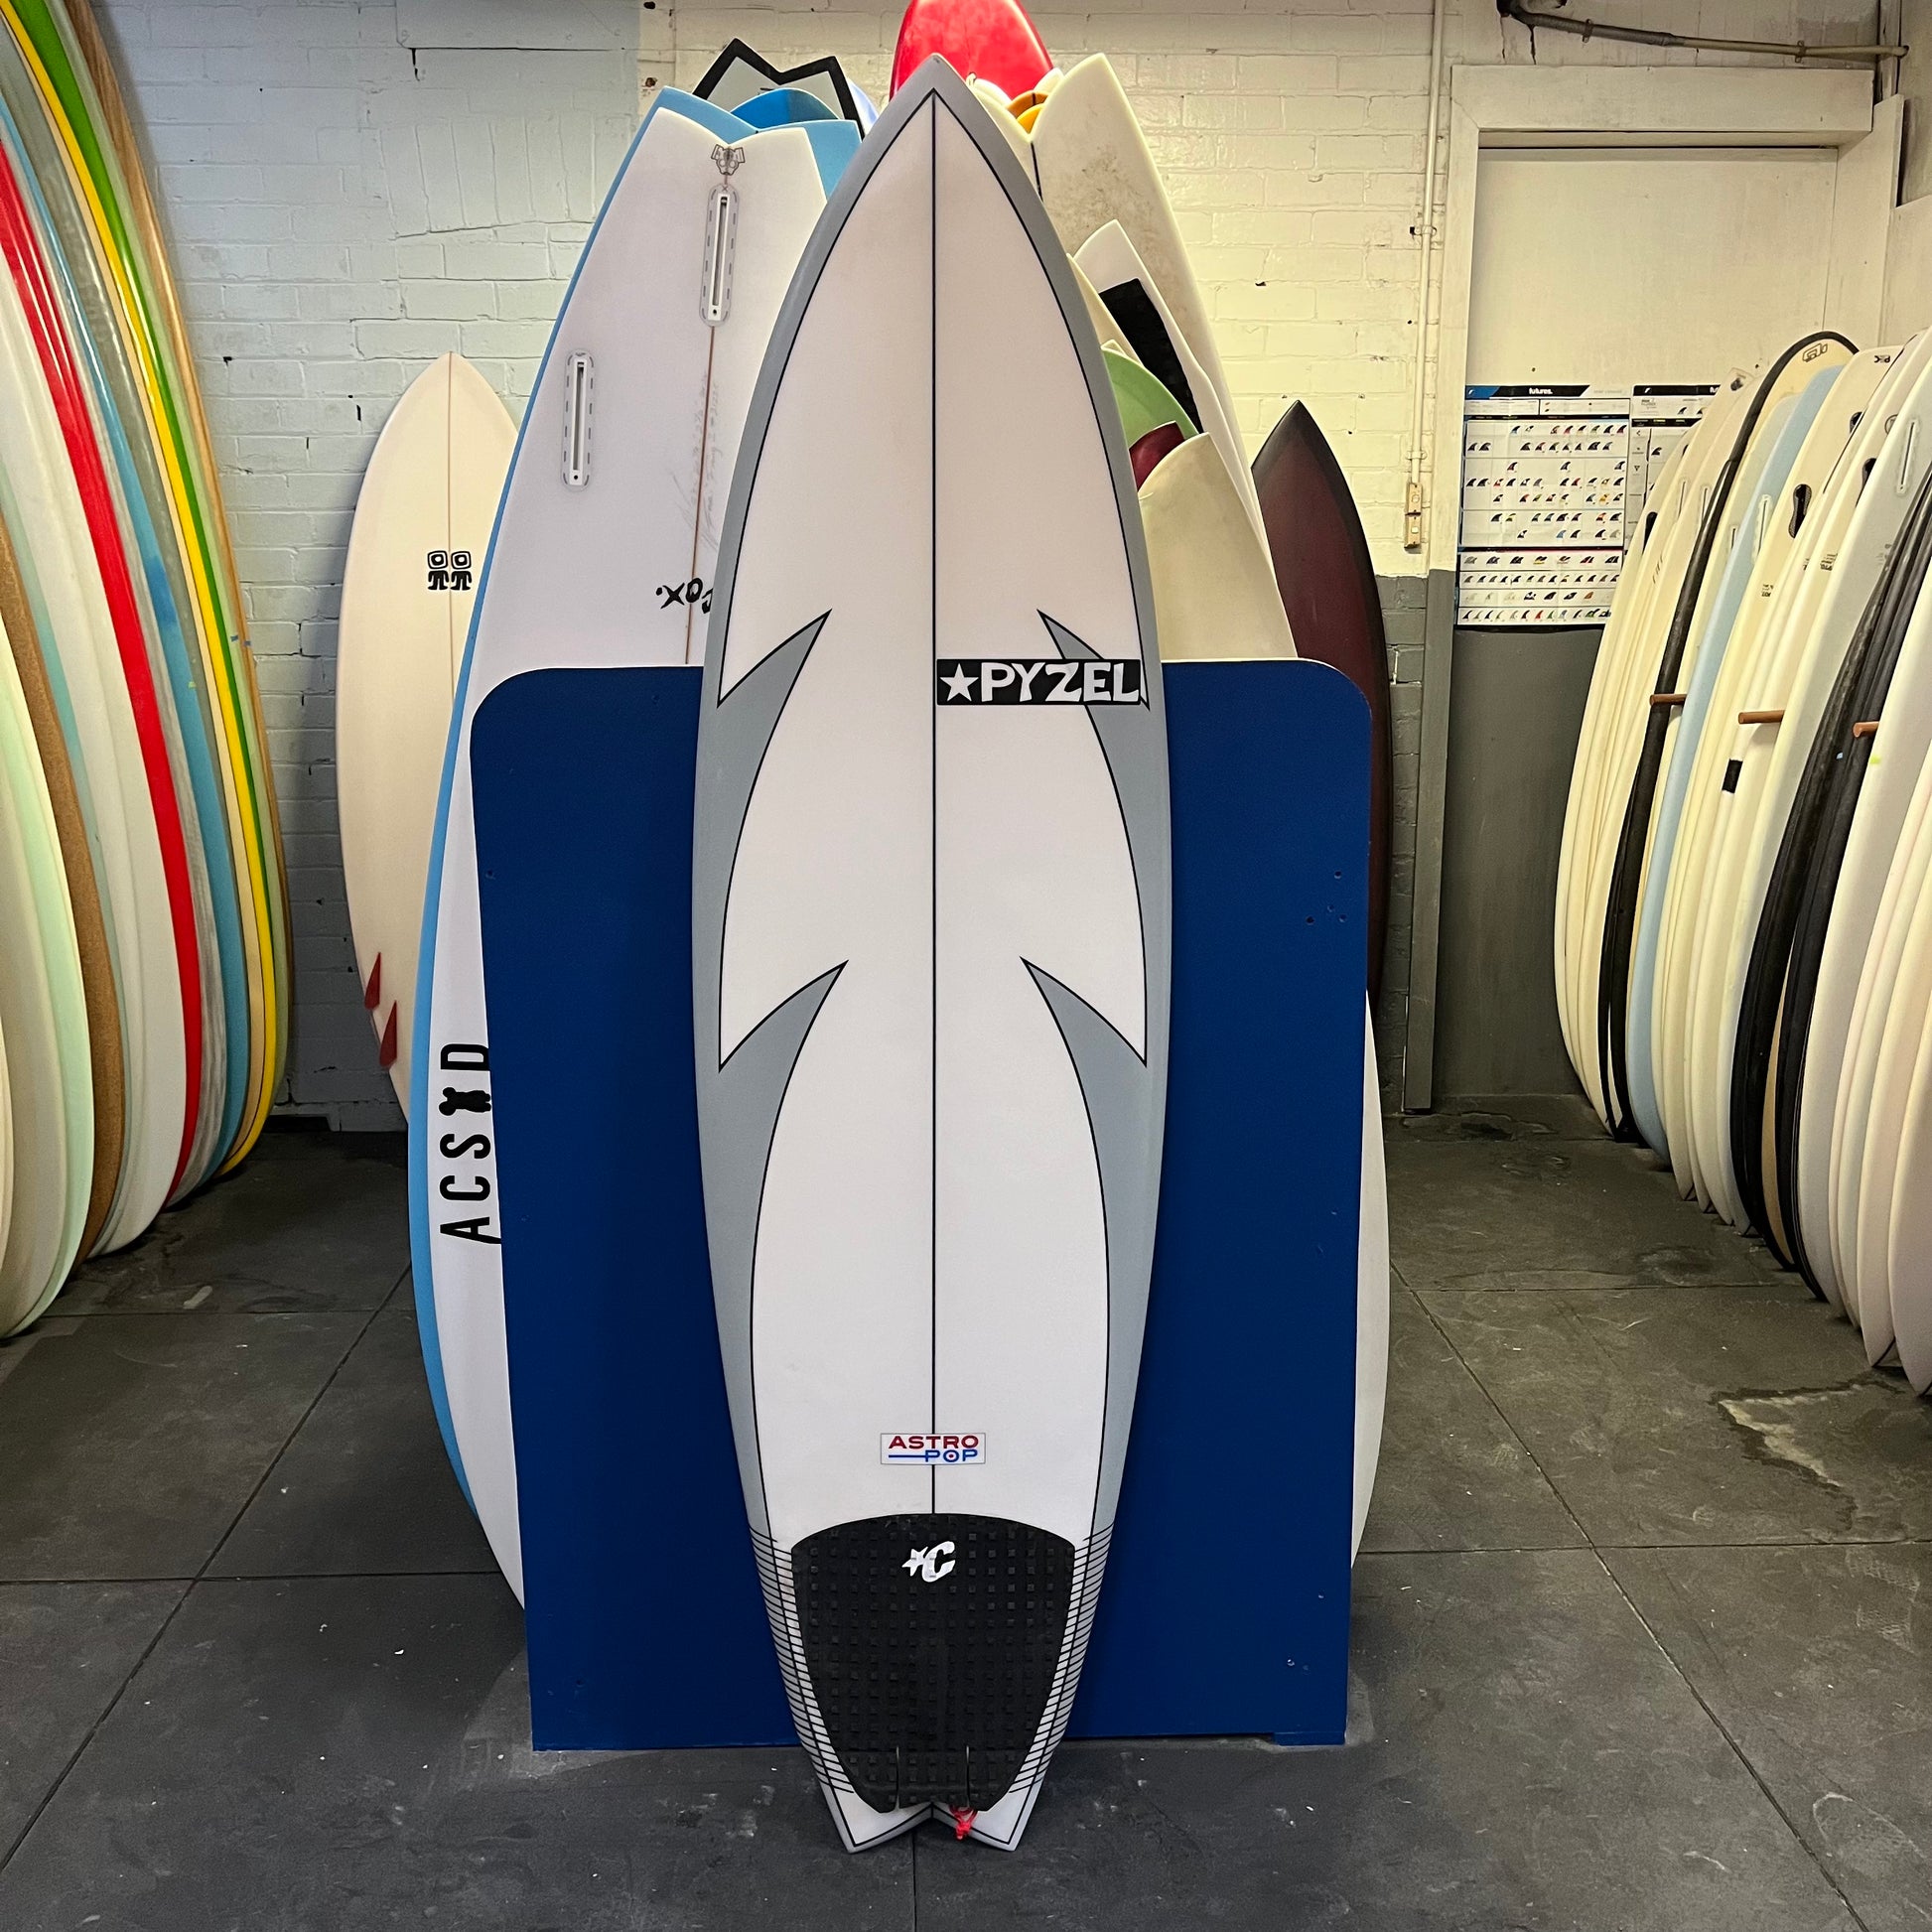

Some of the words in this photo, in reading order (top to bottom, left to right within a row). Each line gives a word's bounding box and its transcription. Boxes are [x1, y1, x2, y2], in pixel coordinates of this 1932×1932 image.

[981, 662, 1139, 702] PYZEL
[888, 1435, 980, 1449] ASTRO
[924, 1449, 978, 1463] POP
